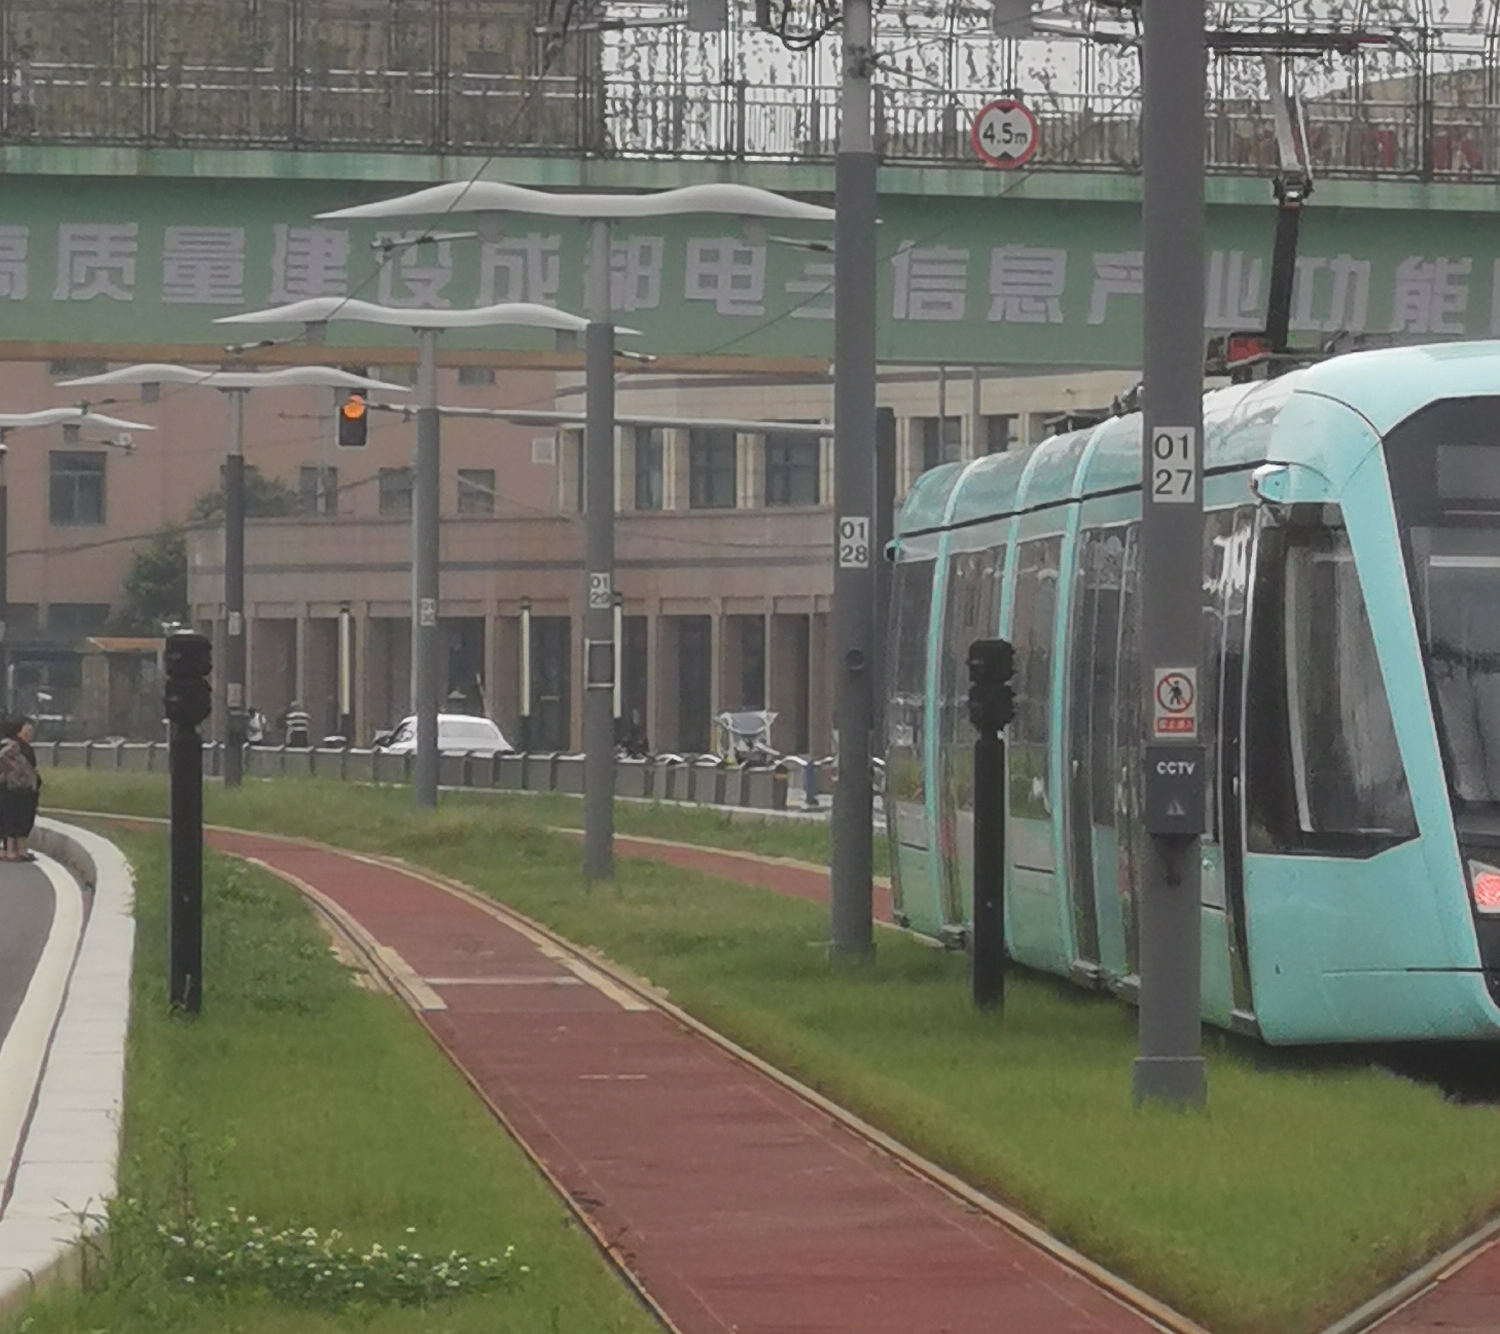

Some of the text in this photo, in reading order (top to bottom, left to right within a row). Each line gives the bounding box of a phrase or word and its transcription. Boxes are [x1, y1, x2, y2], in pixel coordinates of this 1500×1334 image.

[983, 121, 1028, 145] 4.5m
[1154, 433, 1188, 460] 01
[1155, 468, 1193, 495] 27
[841, 521, 865, 540] 01
[841, 544, 868, 564] 28
[1156, 761, 1195, 775] CCTV
